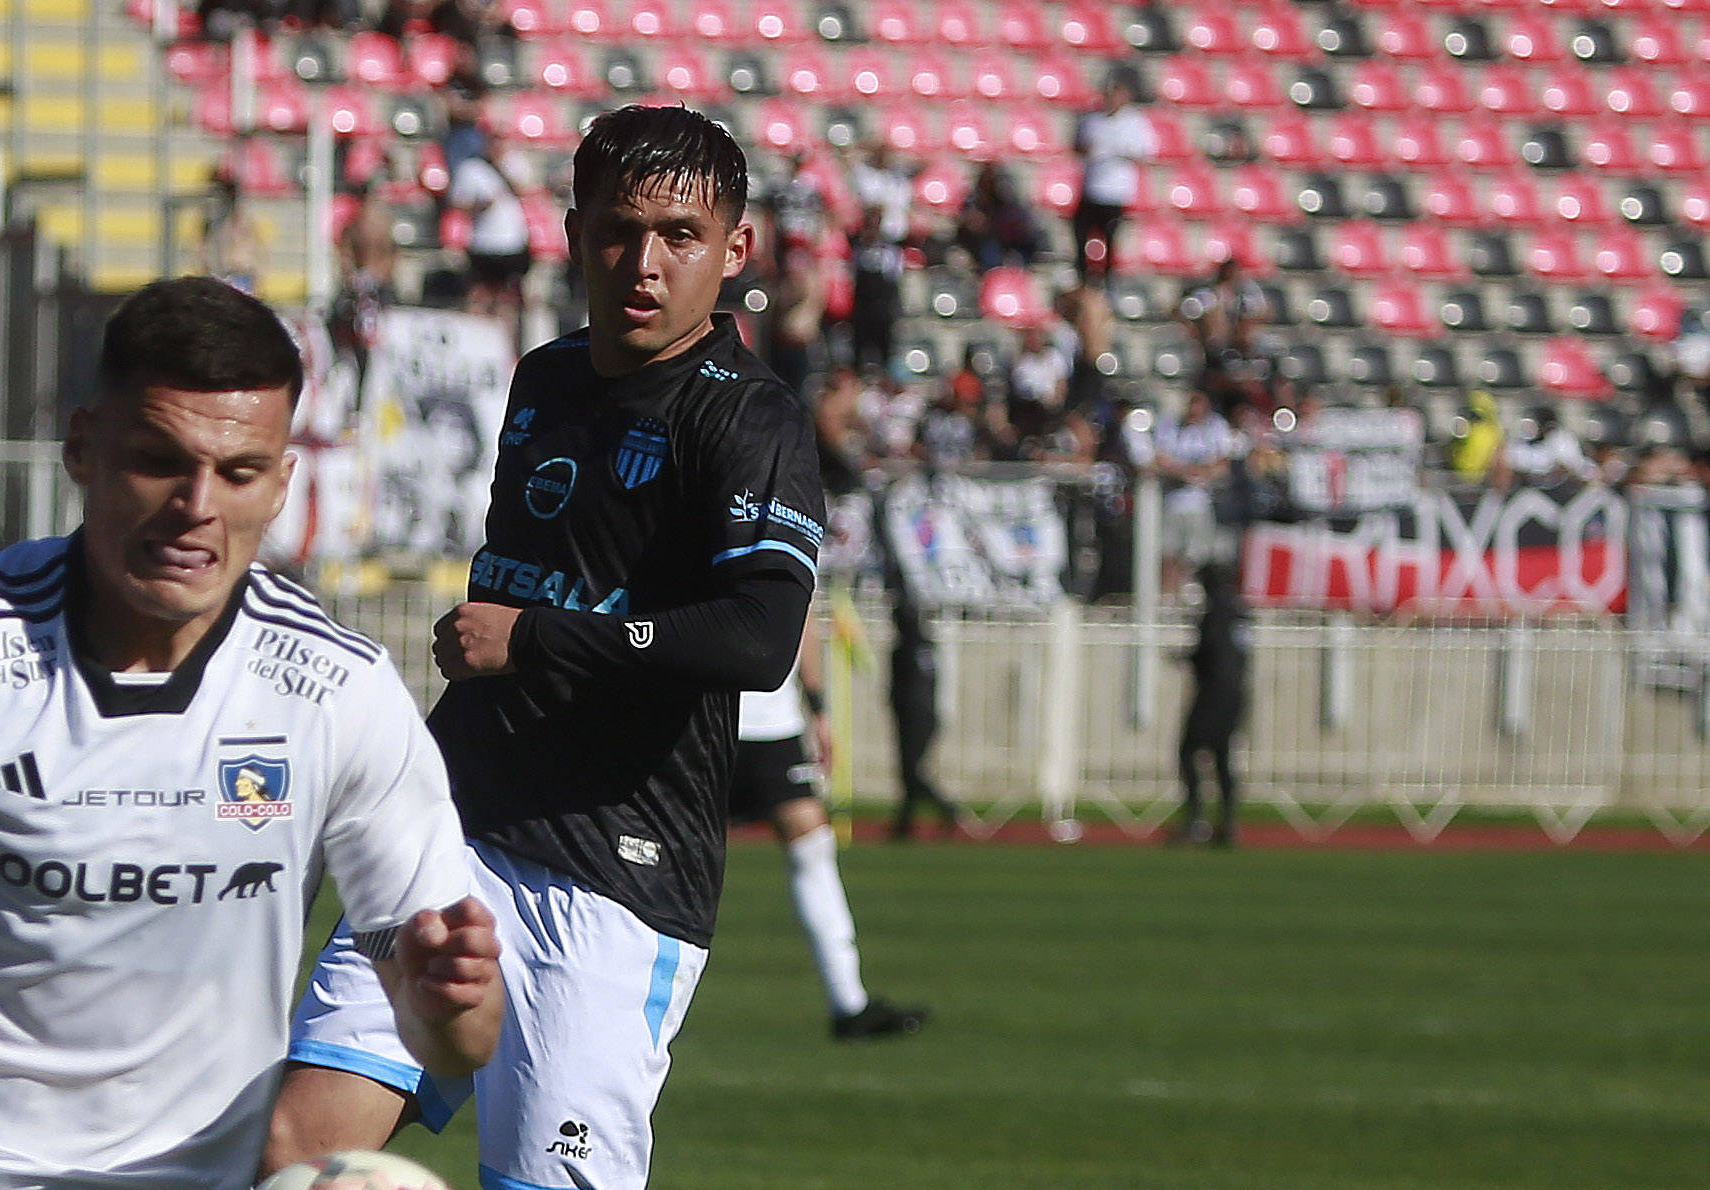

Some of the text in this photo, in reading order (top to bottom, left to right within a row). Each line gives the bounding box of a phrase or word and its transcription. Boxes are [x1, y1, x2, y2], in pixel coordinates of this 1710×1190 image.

[9, 657, 58, 690] Sur
[251, 627, 350, 687] Pilsen
[247, 658, 335, 706] del Sur
[61, 789, 206, 807] JETOUR
[219, 804, 290, 816] COLO-COLO
